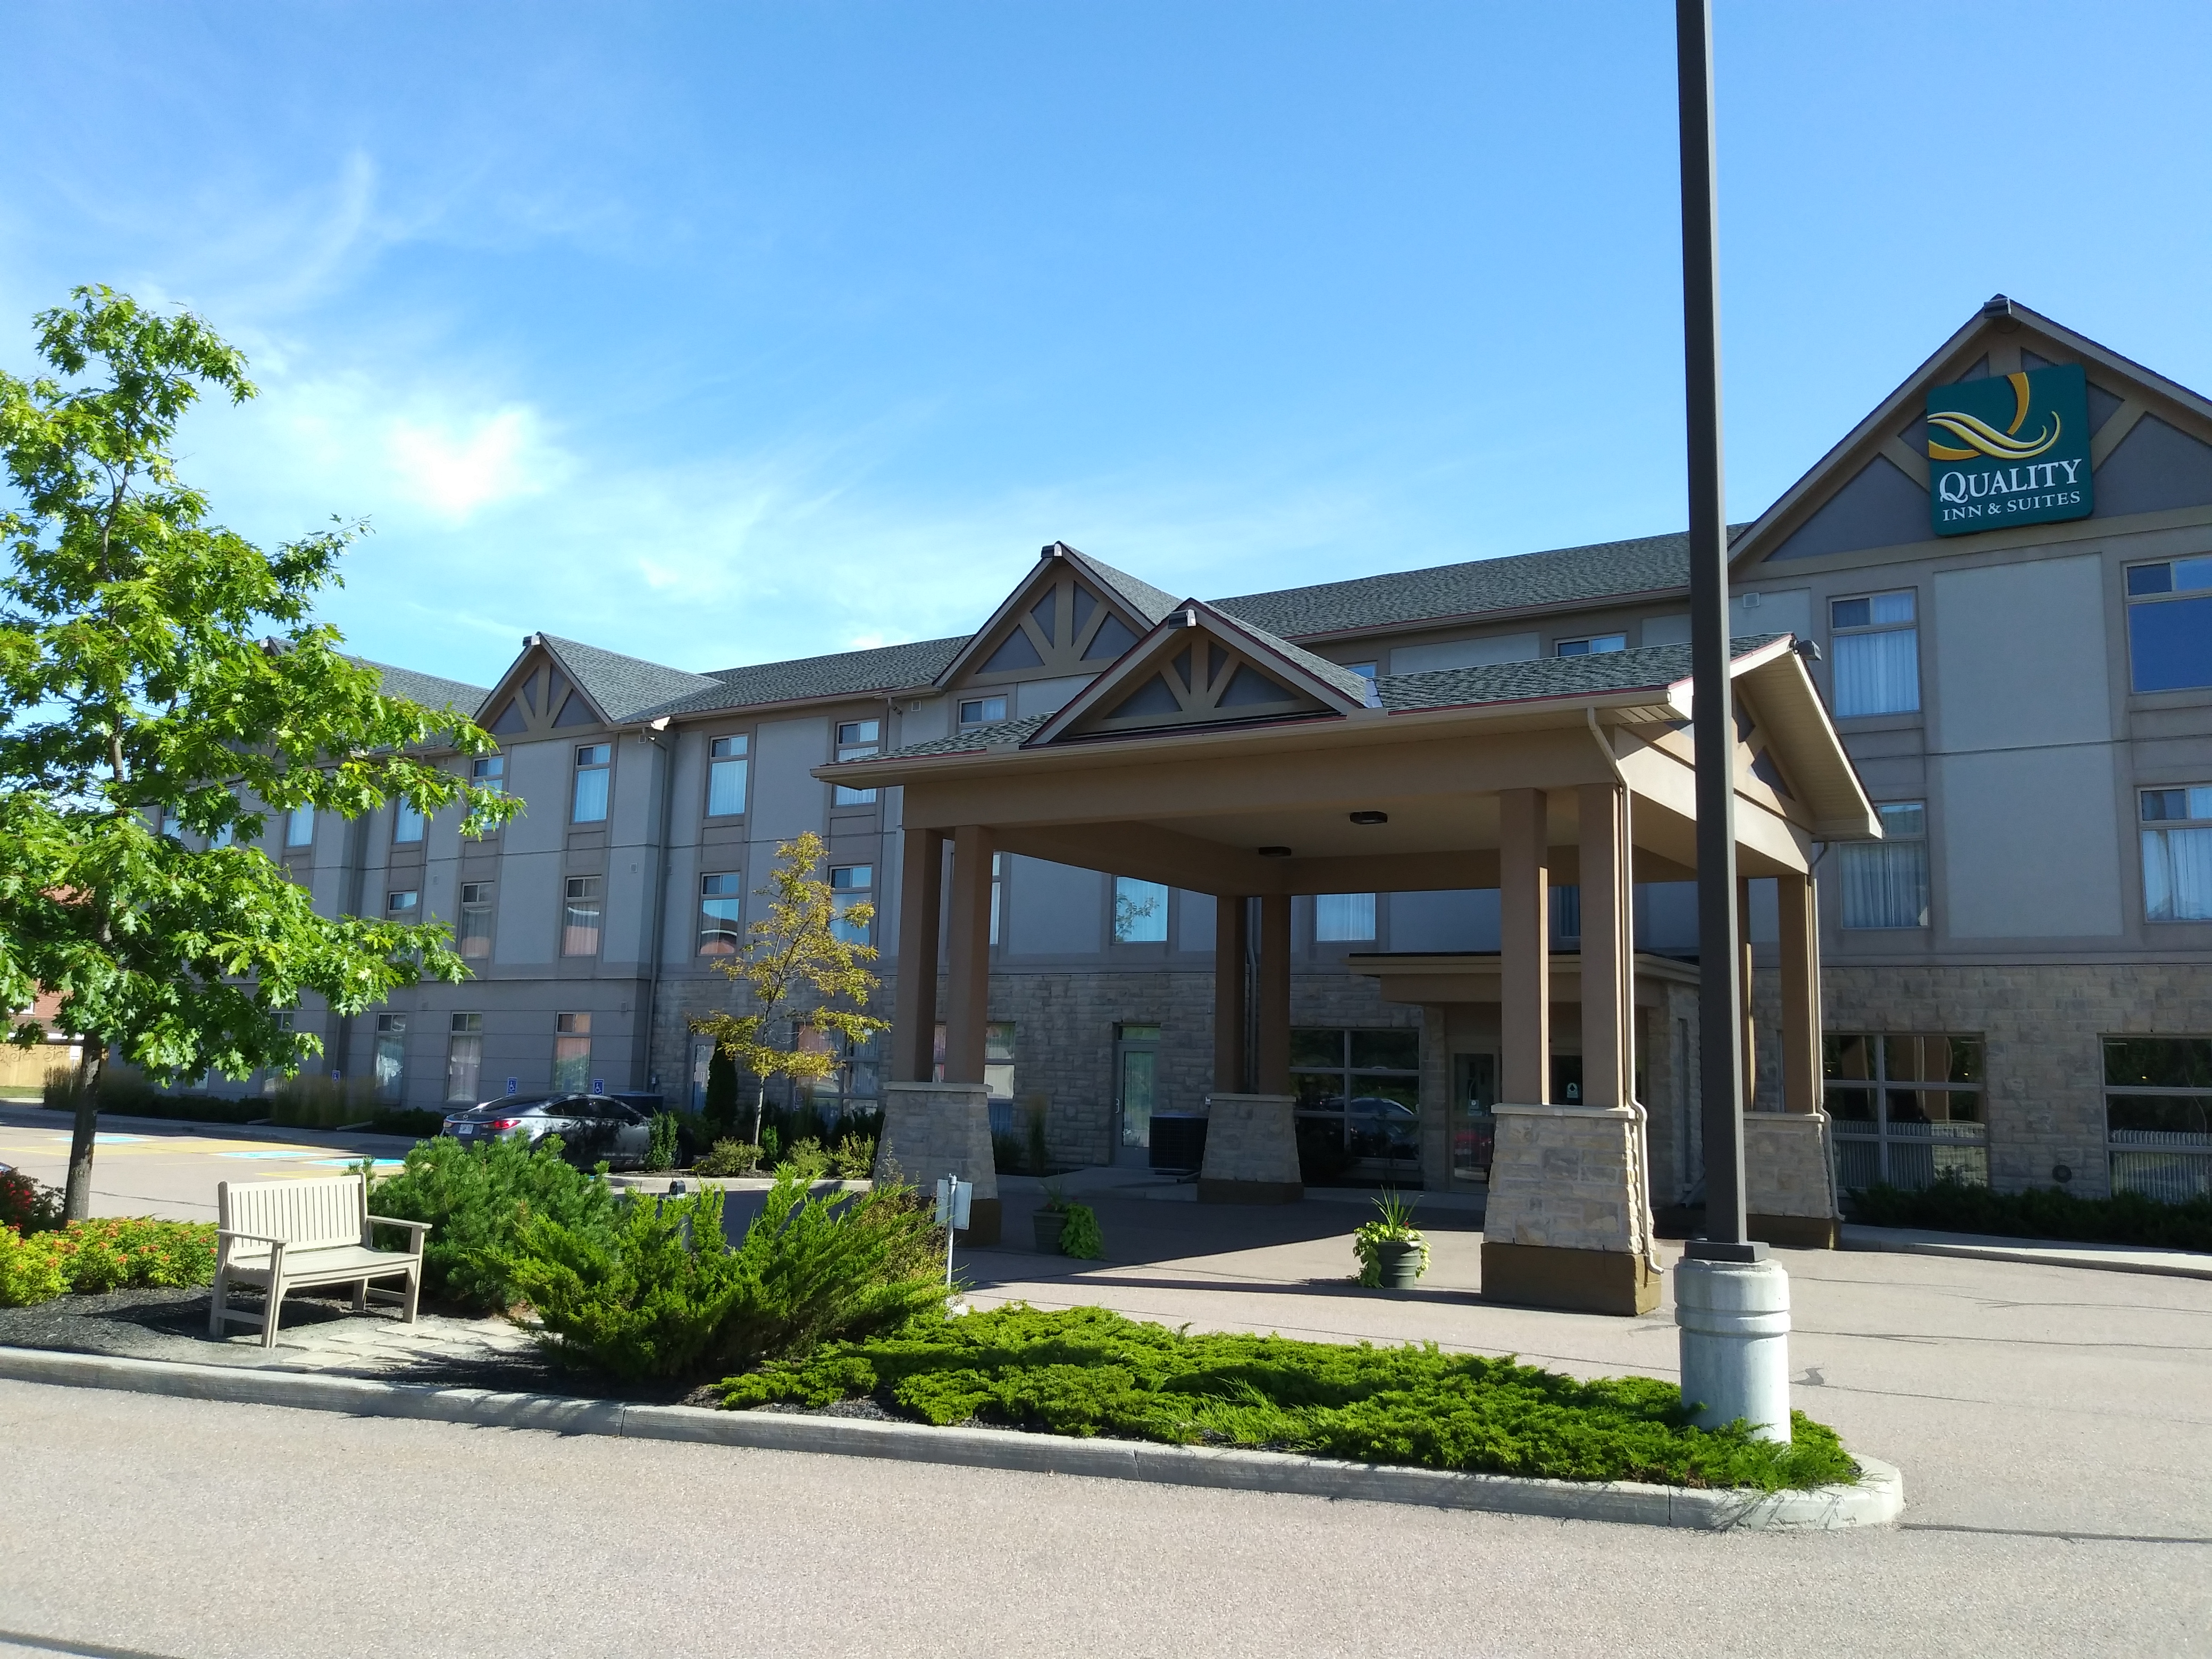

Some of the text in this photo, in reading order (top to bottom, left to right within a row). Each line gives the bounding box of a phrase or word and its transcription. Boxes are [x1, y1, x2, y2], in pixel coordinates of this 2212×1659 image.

[1939, 458, 2082, 504] QUALITY
[1942, 490, 2081, 522] INN & SUITES
